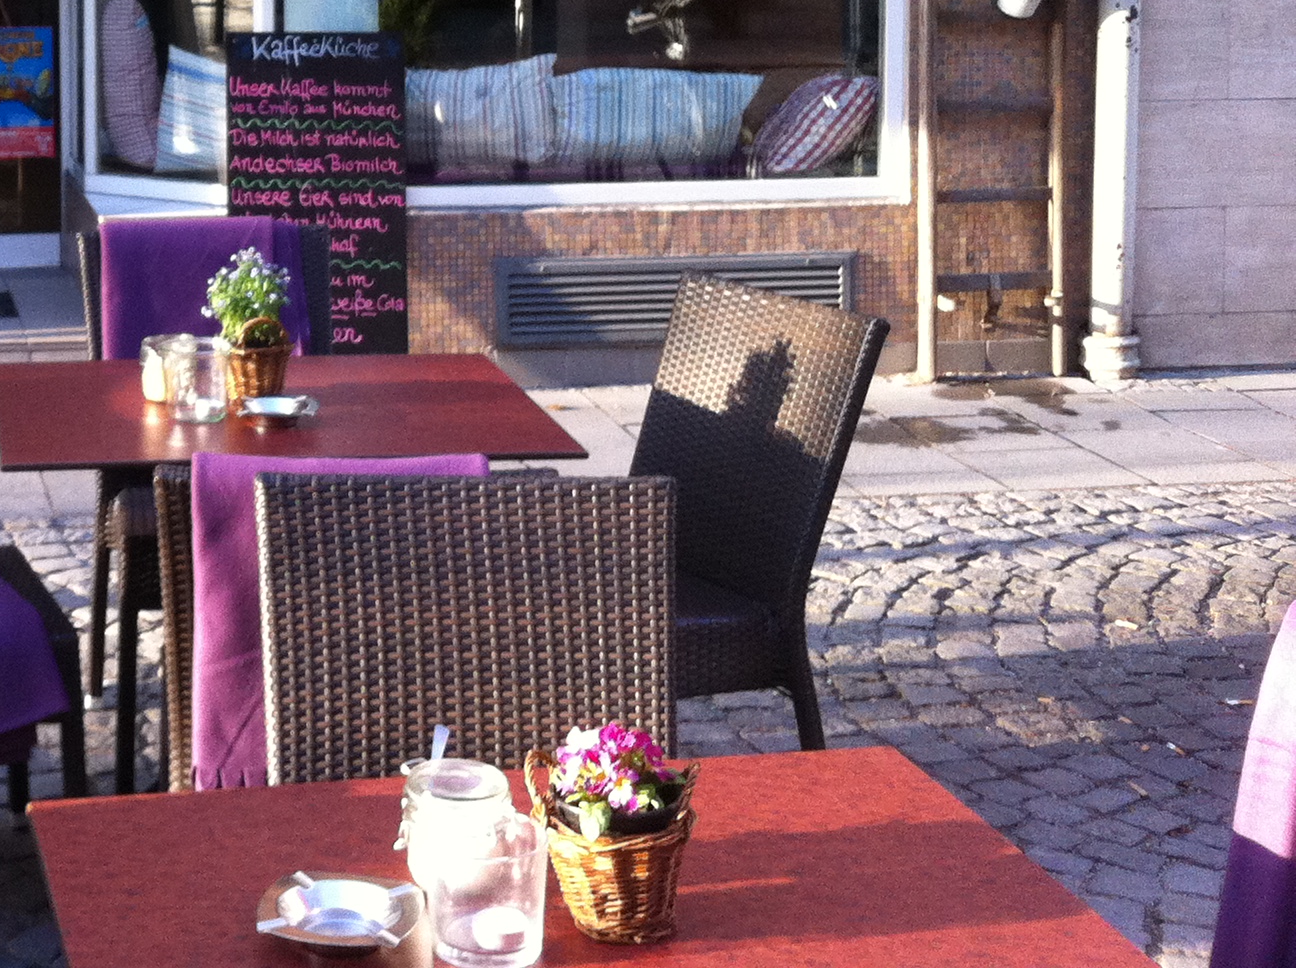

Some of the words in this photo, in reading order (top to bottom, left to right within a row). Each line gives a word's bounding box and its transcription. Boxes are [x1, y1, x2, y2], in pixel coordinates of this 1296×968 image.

[229, 75, 278, 98] Unser
[280, 75, 329, 101] Kaffee
[333, 79, 393, 99] kommt
[231, 101, 255, 116] von
[332, 99, 402, 120] München
[230, 128, 258, 147] Die
[259, 129, 300, 148] Milch
[300, 131, 323, 147] ist
[324, 128, 401, 149] natürlich
[229, 153, 326, 174] Andechser
[324, 152, 405, 175] Biomilch
[230, 186, 293, 207] Unsere
[298, 182, 335, 208] Eier
[337, 188, 379, 208] sind
[378, 195, 406, 208] von
